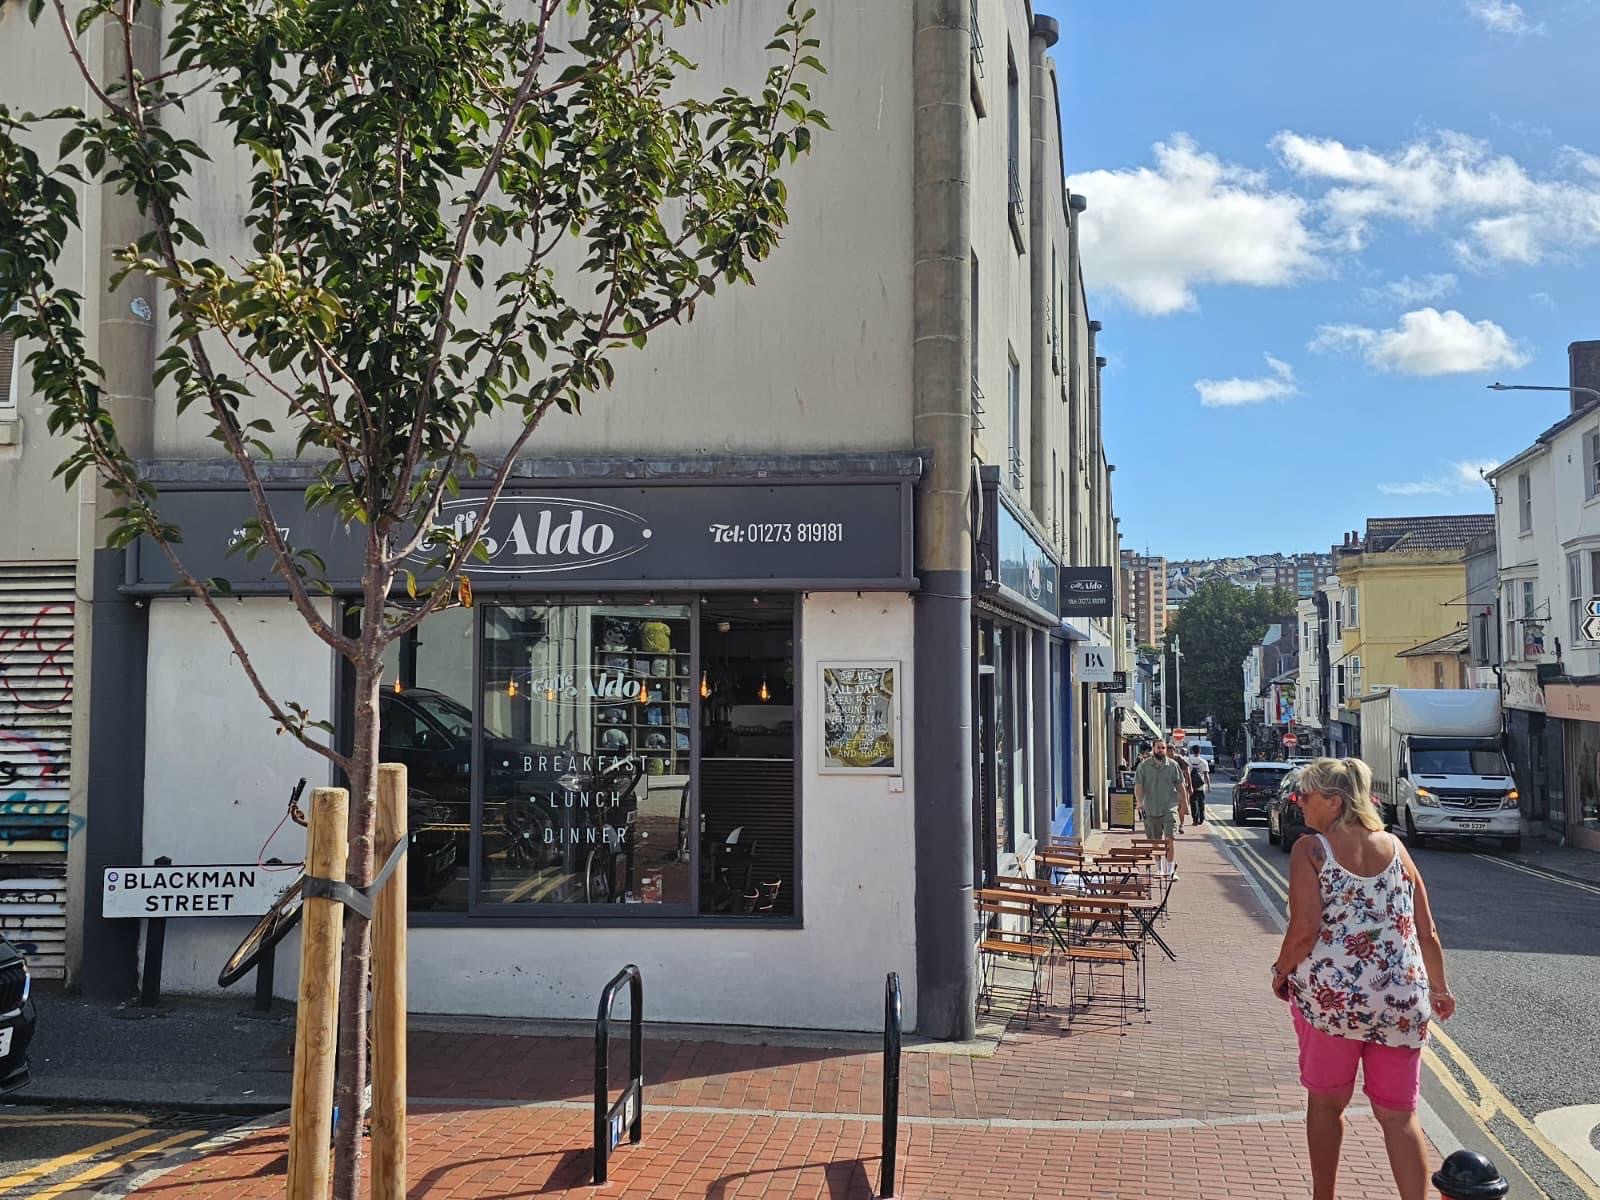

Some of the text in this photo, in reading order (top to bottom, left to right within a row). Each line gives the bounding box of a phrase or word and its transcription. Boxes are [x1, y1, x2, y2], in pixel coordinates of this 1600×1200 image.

[502, 510, 615, 557] Aldo
[709, 523, 843, 543] Tel: 01273 819181
[582, 671, 641, 698] Aldo
[833, 683, 878, 694] ALL DAY
[838, 749, 887, 758] AND MORE
[523, 755, 649, 772] BREAKFAST
[550, 791, 620, 808] LUNCH
[544, 827, 626, 844] DINNER
[124, 871, 255, 890] BLACKMAN
[145, 894, 234, 912] STREET
